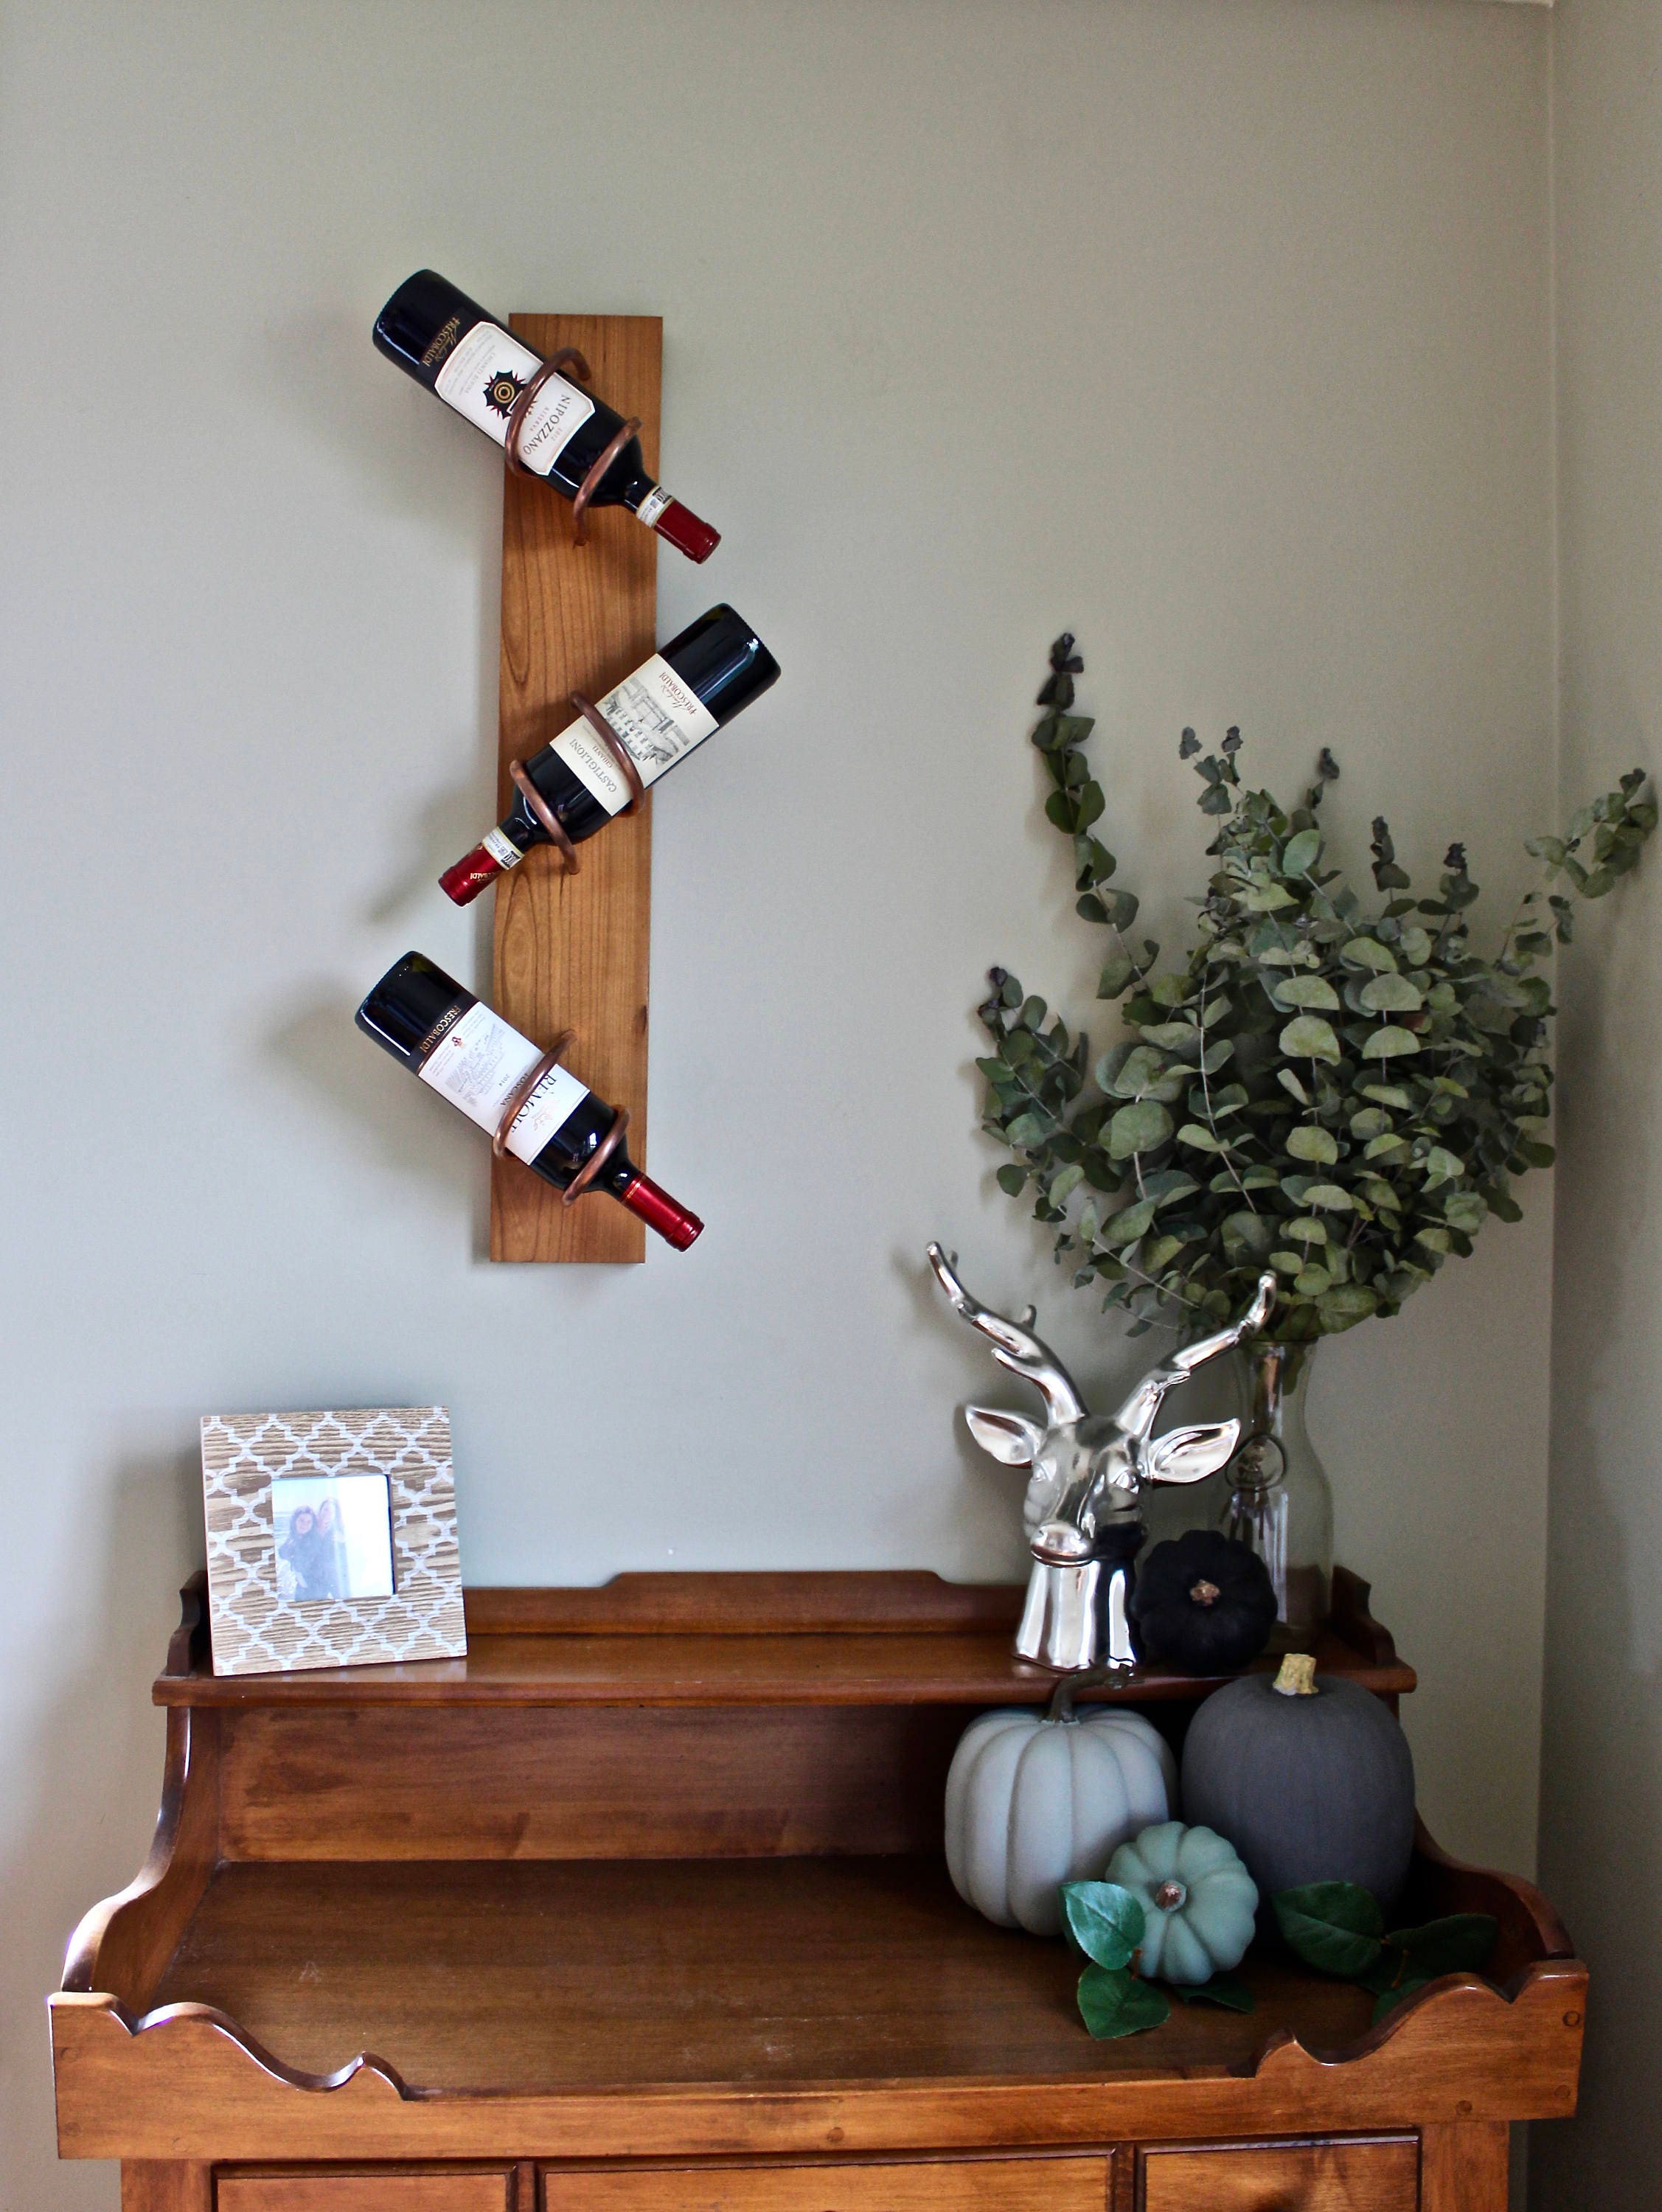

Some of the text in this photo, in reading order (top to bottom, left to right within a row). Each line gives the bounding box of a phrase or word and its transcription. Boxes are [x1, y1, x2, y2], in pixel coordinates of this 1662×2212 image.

[422, 316, 459, 366] FRESCOBALDI
[522, 394, 571, 454] NIPOZZANO
[528, 406, 549, 433] RISERVA
[658, 671, 698, 716] FRESCOBALDI
[568, 737, 617, 793] CASTIGLIONI
[591, 744, 613, 768] CHIANTI
[418, 1003, 461, 1054] FRESCOBALDI
[499, 1071, 529, 1107] TOSCANA
